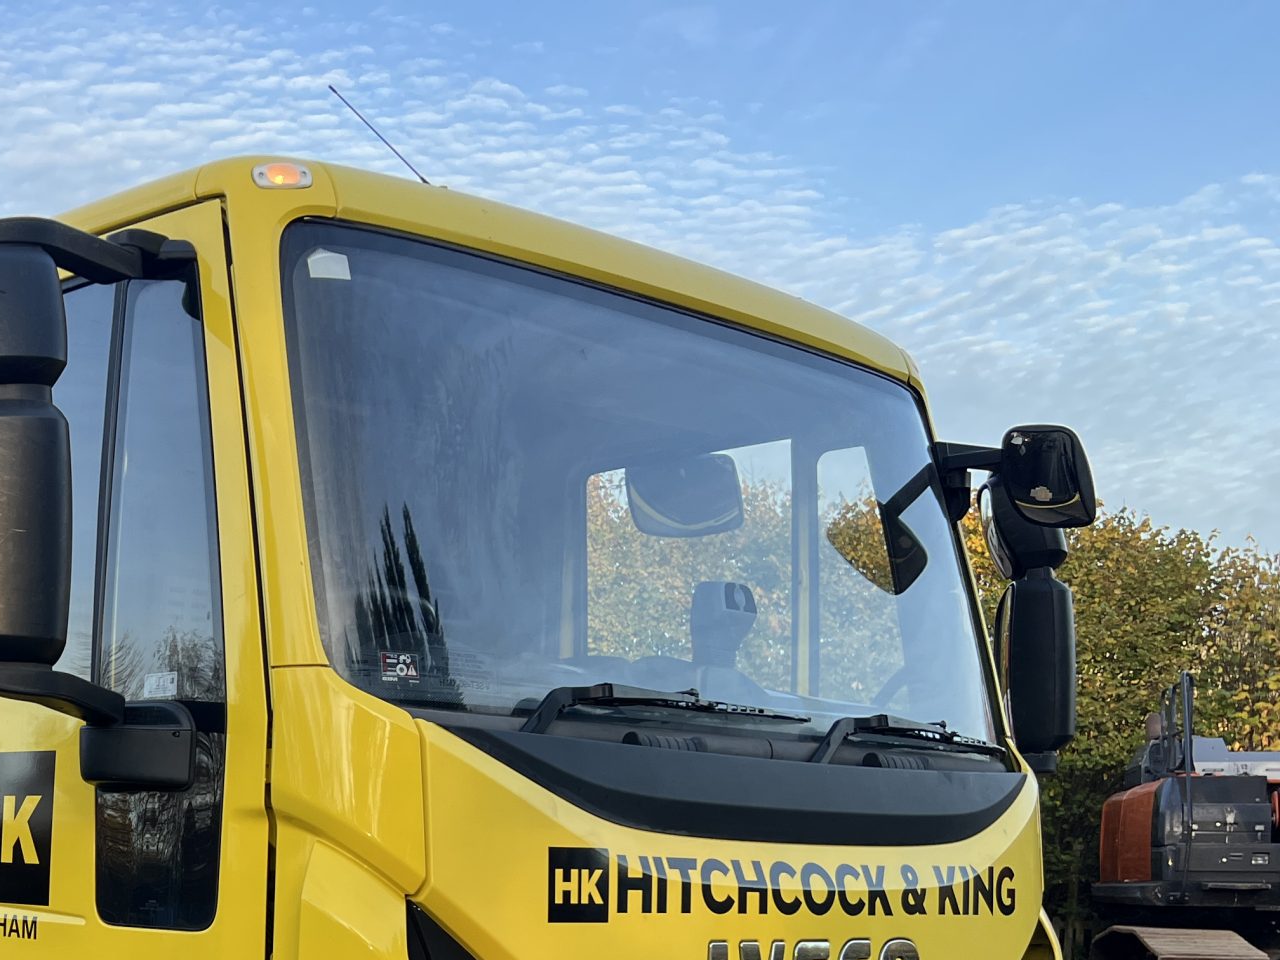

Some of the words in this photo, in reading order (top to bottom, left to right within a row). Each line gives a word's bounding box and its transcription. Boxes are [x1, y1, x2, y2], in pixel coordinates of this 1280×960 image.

[554, 868, 605, 905] HK
[616, 853, 894, 917] HITCHCOCK
[900, 863, 927, 917] &
[931, 863, 1017, 917] KING
